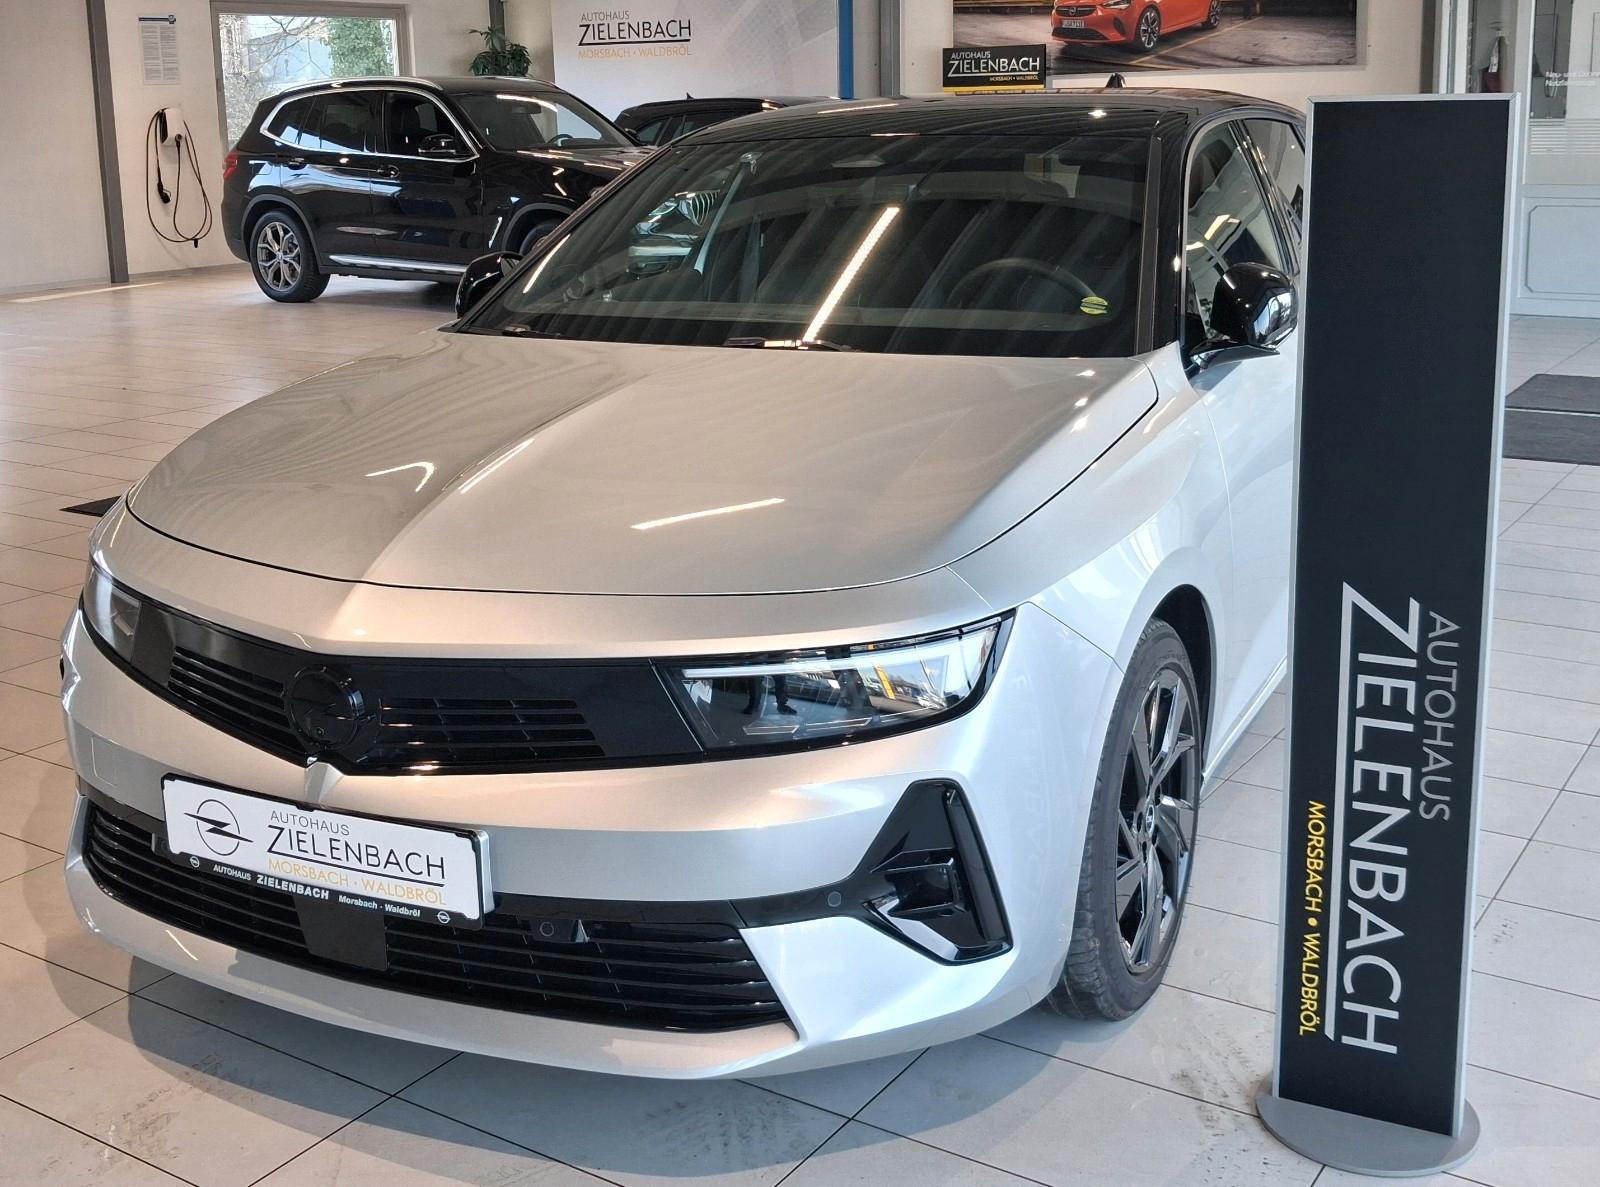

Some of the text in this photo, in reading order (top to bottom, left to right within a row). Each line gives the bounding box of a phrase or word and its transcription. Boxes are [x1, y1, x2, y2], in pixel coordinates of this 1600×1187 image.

[578, 19, 691, 46] ZIELENBACH
[581, 10, 630, 22] AUTOHAUS
[578, 44, 691, 59] MORSBACH WALDBRÖL
[947, 57, 1040, 77] ZIELENBACH
[950, 50, 991, 60] AUTOHAUS
[1418, 610, 1461, 821] AUTOHAUS
[270, 810, 350, 836] AUTOHAUS
[1324, 581, 1420, 1054] ZIELENBACH
[266, 824, 446, 886] ZIELENBACH
[213, 864, 421, 918] AUTOHAUS ZIELENBACH Morsbach Waldbröl
[268, 858, 447, 906] MORSBACH WALDBRÖL
[1299, 800, 1327, 1036] MORSBACH WALDBRÖL
